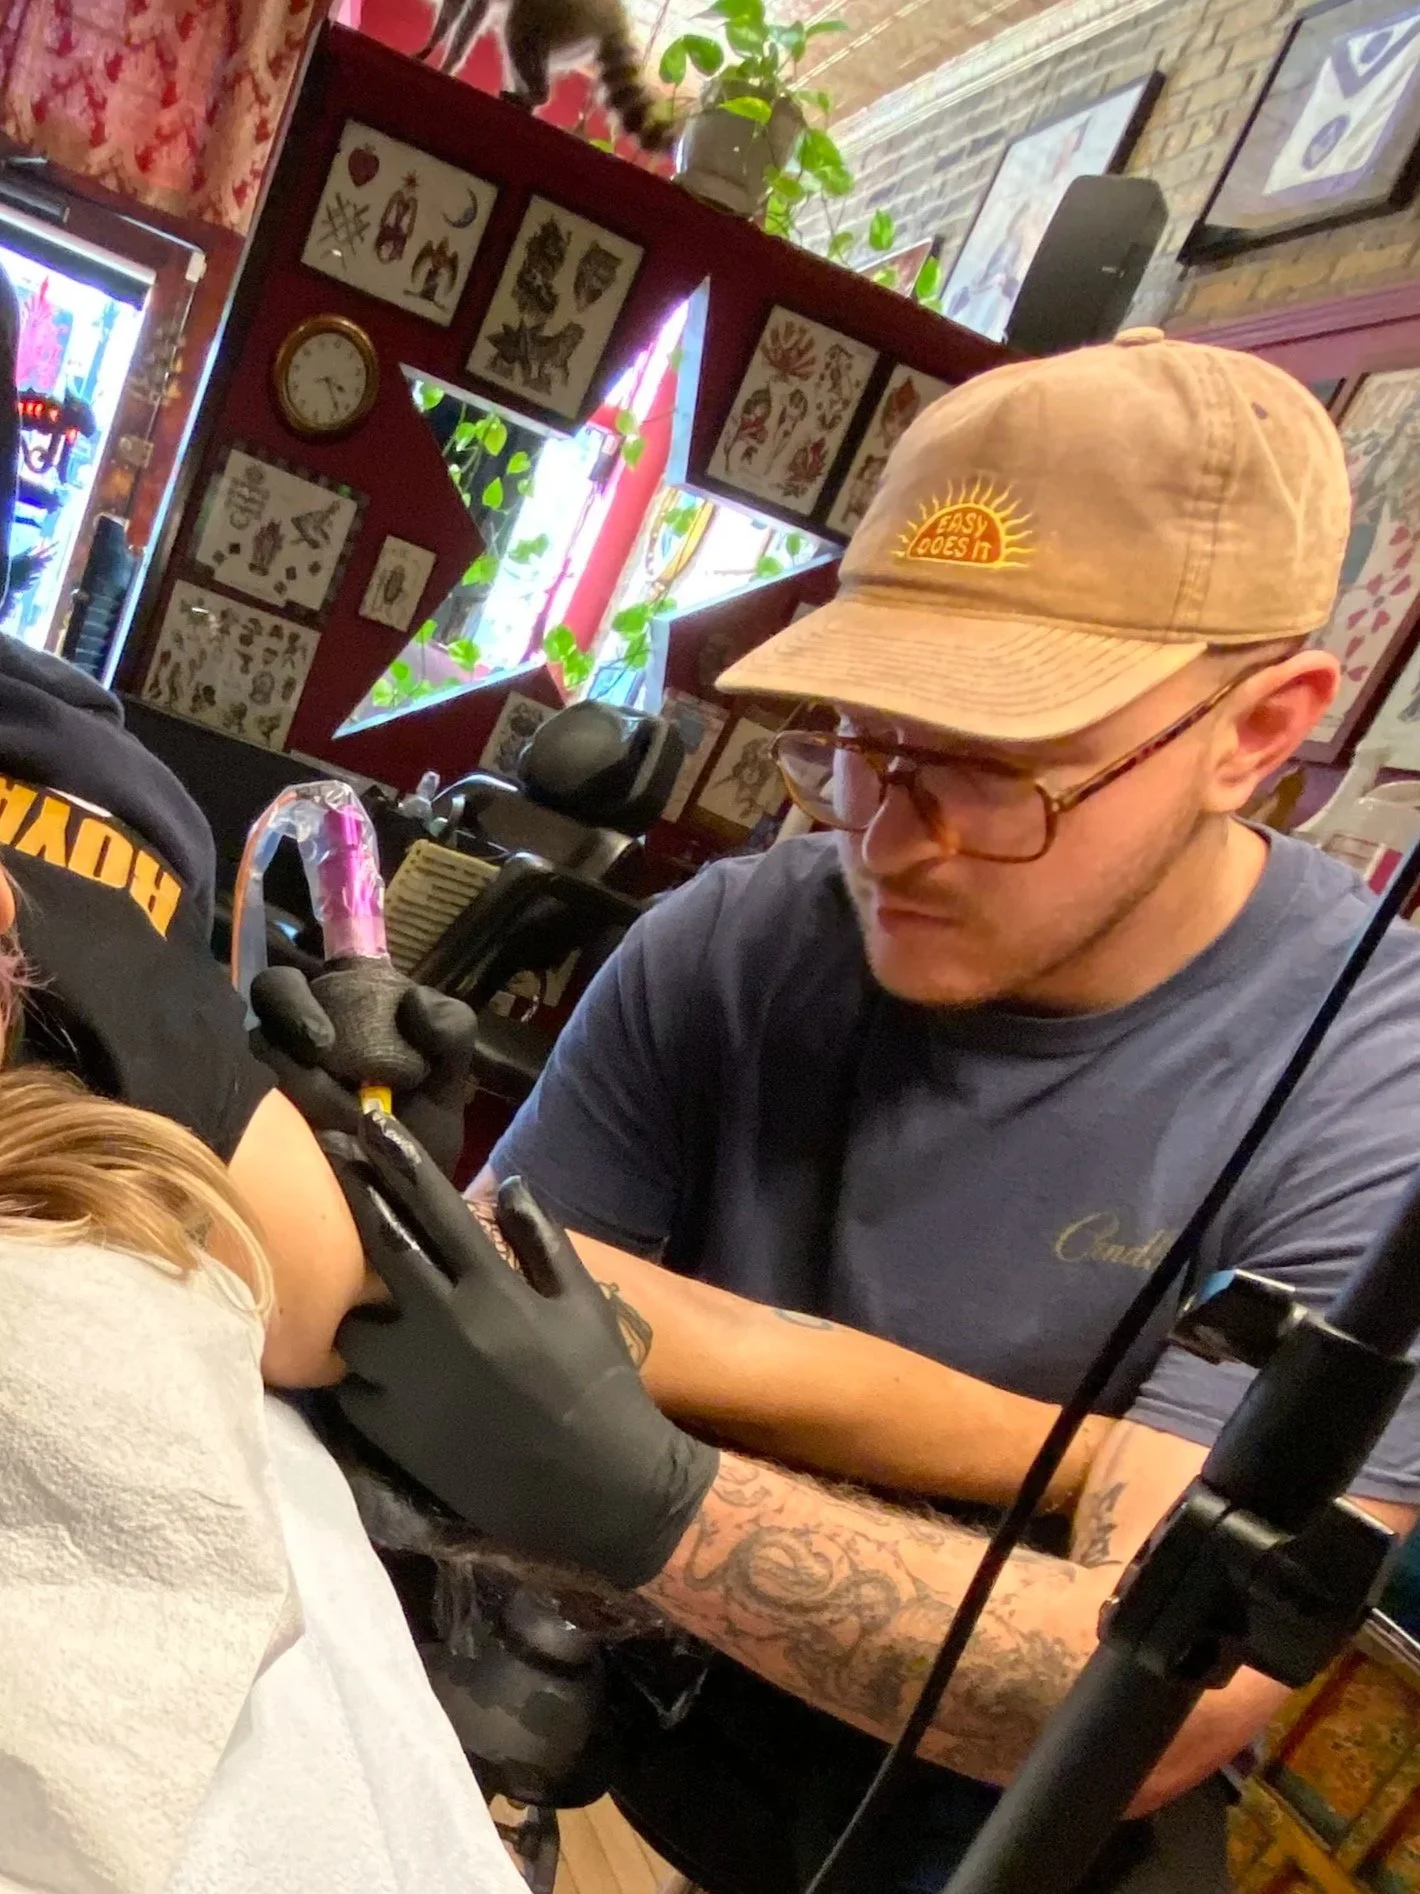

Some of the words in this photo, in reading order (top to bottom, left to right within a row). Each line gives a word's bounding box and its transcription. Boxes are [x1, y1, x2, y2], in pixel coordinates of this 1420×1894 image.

[936, 512, 988, 539] EASY
[916, 535, 970, 558] DOES
[971, 539, 993, 561] IT
